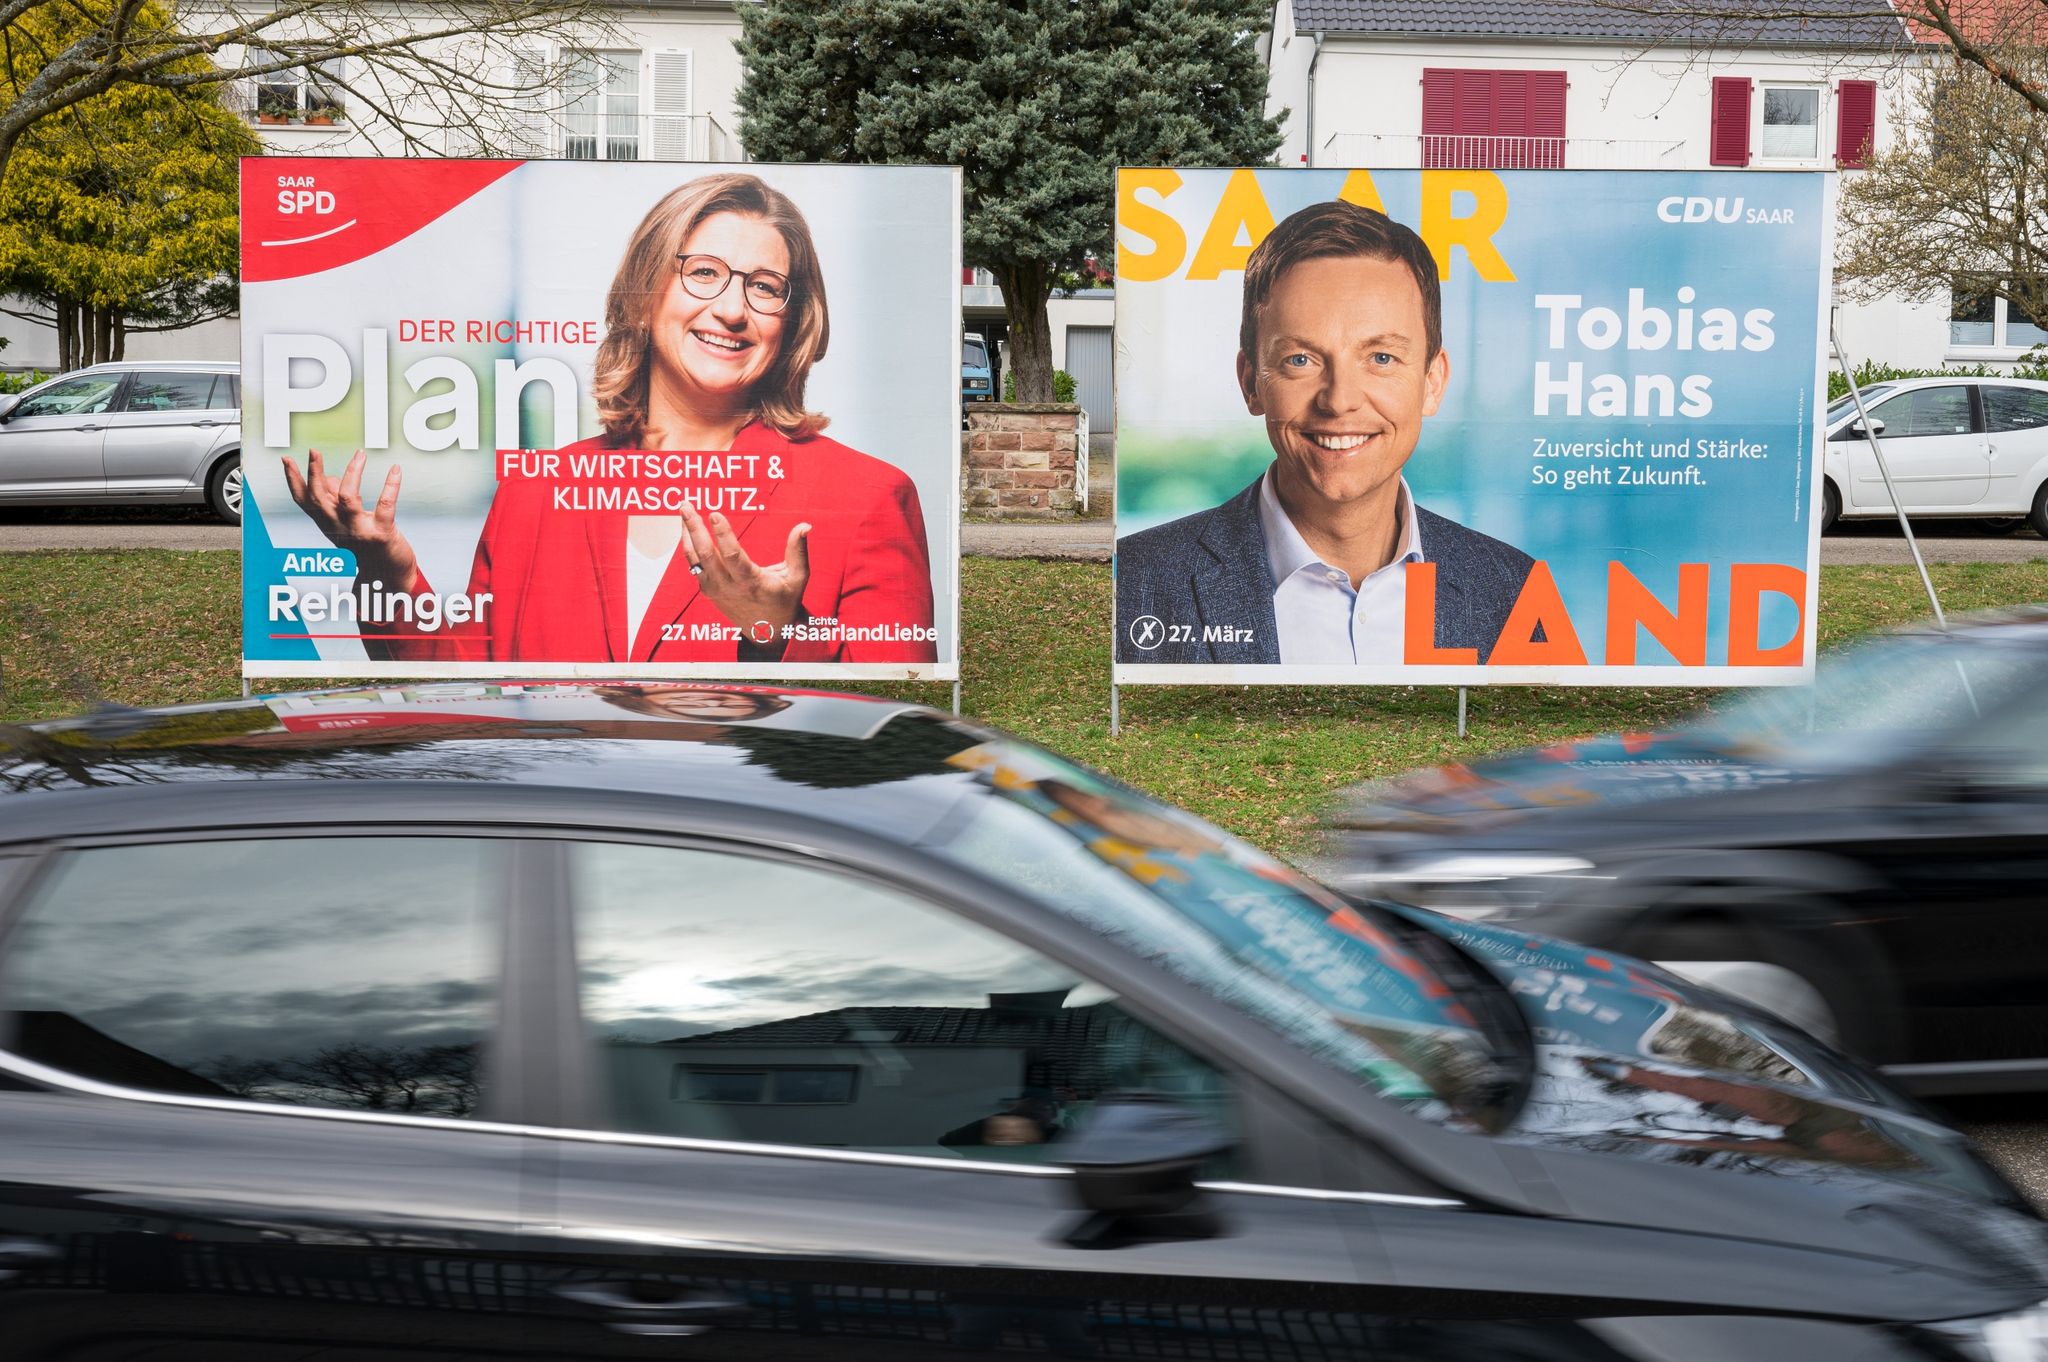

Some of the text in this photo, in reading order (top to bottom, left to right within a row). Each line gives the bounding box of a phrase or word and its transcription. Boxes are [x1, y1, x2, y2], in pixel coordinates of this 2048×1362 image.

[278, 176, 315, 188] SAAR
[278, 191, 336, 214] SPD
[1656, 196, 1794, 224] CDU SAAR
[1535, 286, 1775, 352] Tobias
[399, 320, 597, 344] DER RICHTIGE
[263, 328, 579, 452] Plan
[1533, 362, 1713, 417] Hans
[1532, 438, 1768, 459] Zuversicht und Stärke:
[503, 449, 785, 479] FÜR WIRTSCHAFT &
[1531, 466, 1706, 490] So geht Zukunft.
[554, 486, 765, 511] KLIMASCHUTZ.
[282, 552, 344, 573] Anke
[268, 580, 494, 632] Rehlinger
[1403, 560, 1807, 666] LAND
[661, 622, 939, 642] 27. März #SaarlandLiebe
[808, 616, 838, 626] Echte
[1168, 625, 1254, 643] 27. März
